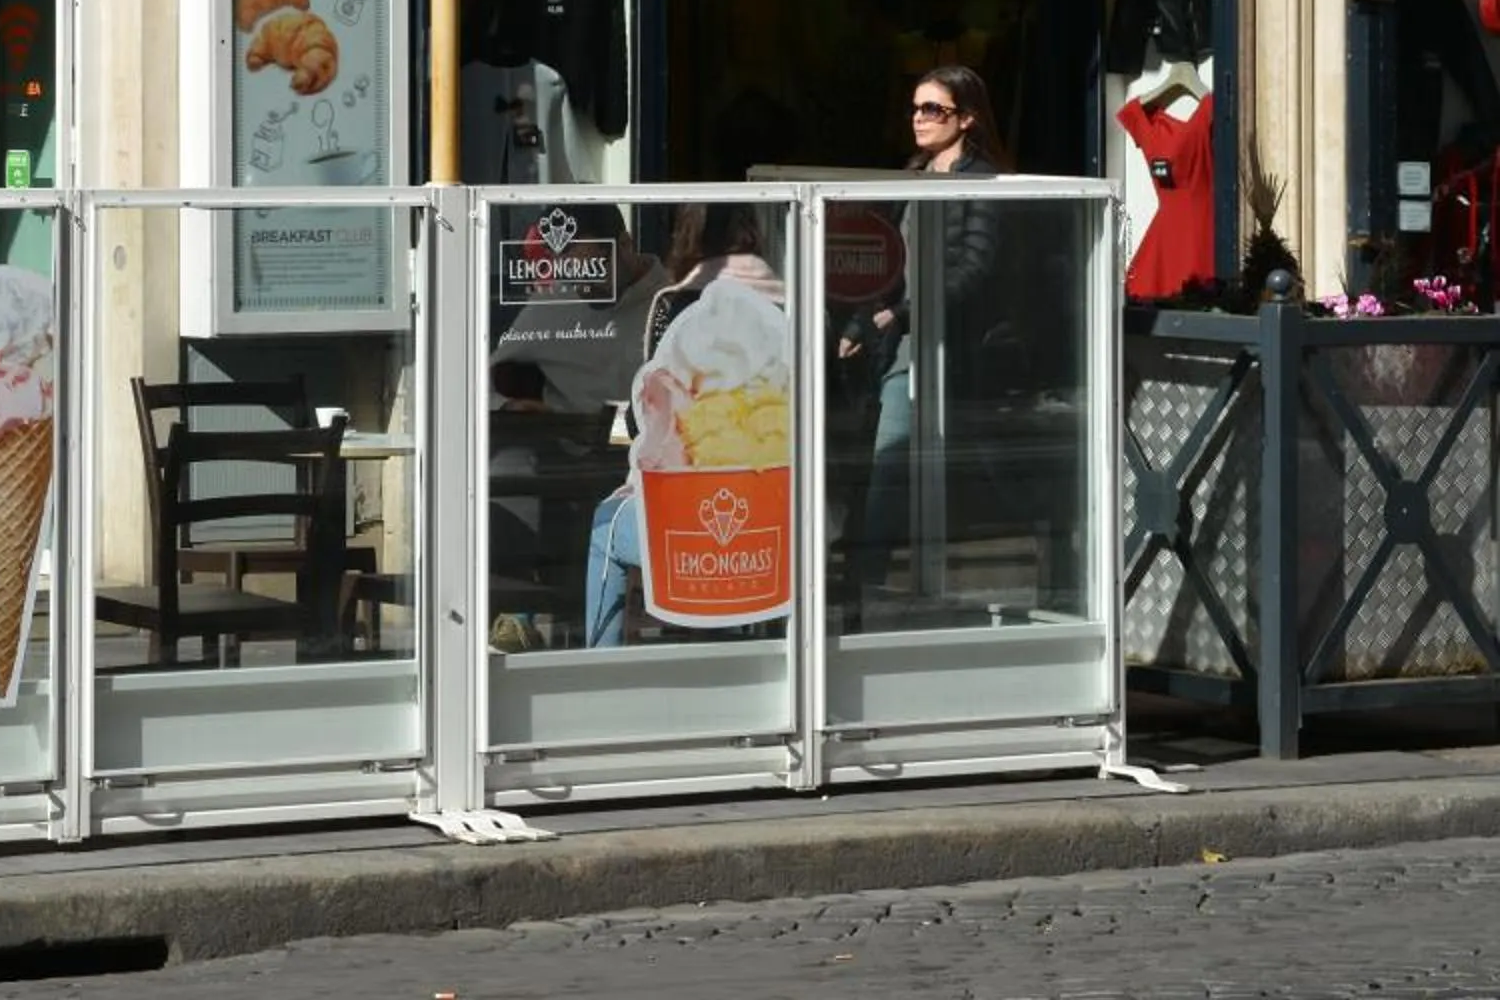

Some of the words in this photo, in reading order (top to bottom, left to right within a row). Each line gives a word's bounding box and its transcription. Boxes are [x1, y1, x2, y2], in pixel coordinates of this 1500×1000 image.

[250, 228, 333, 244] BREAKFAST
[508, 257, 608, 279] LEMONGRASS
[674, 547, 773, 576] LEMONGRASS
